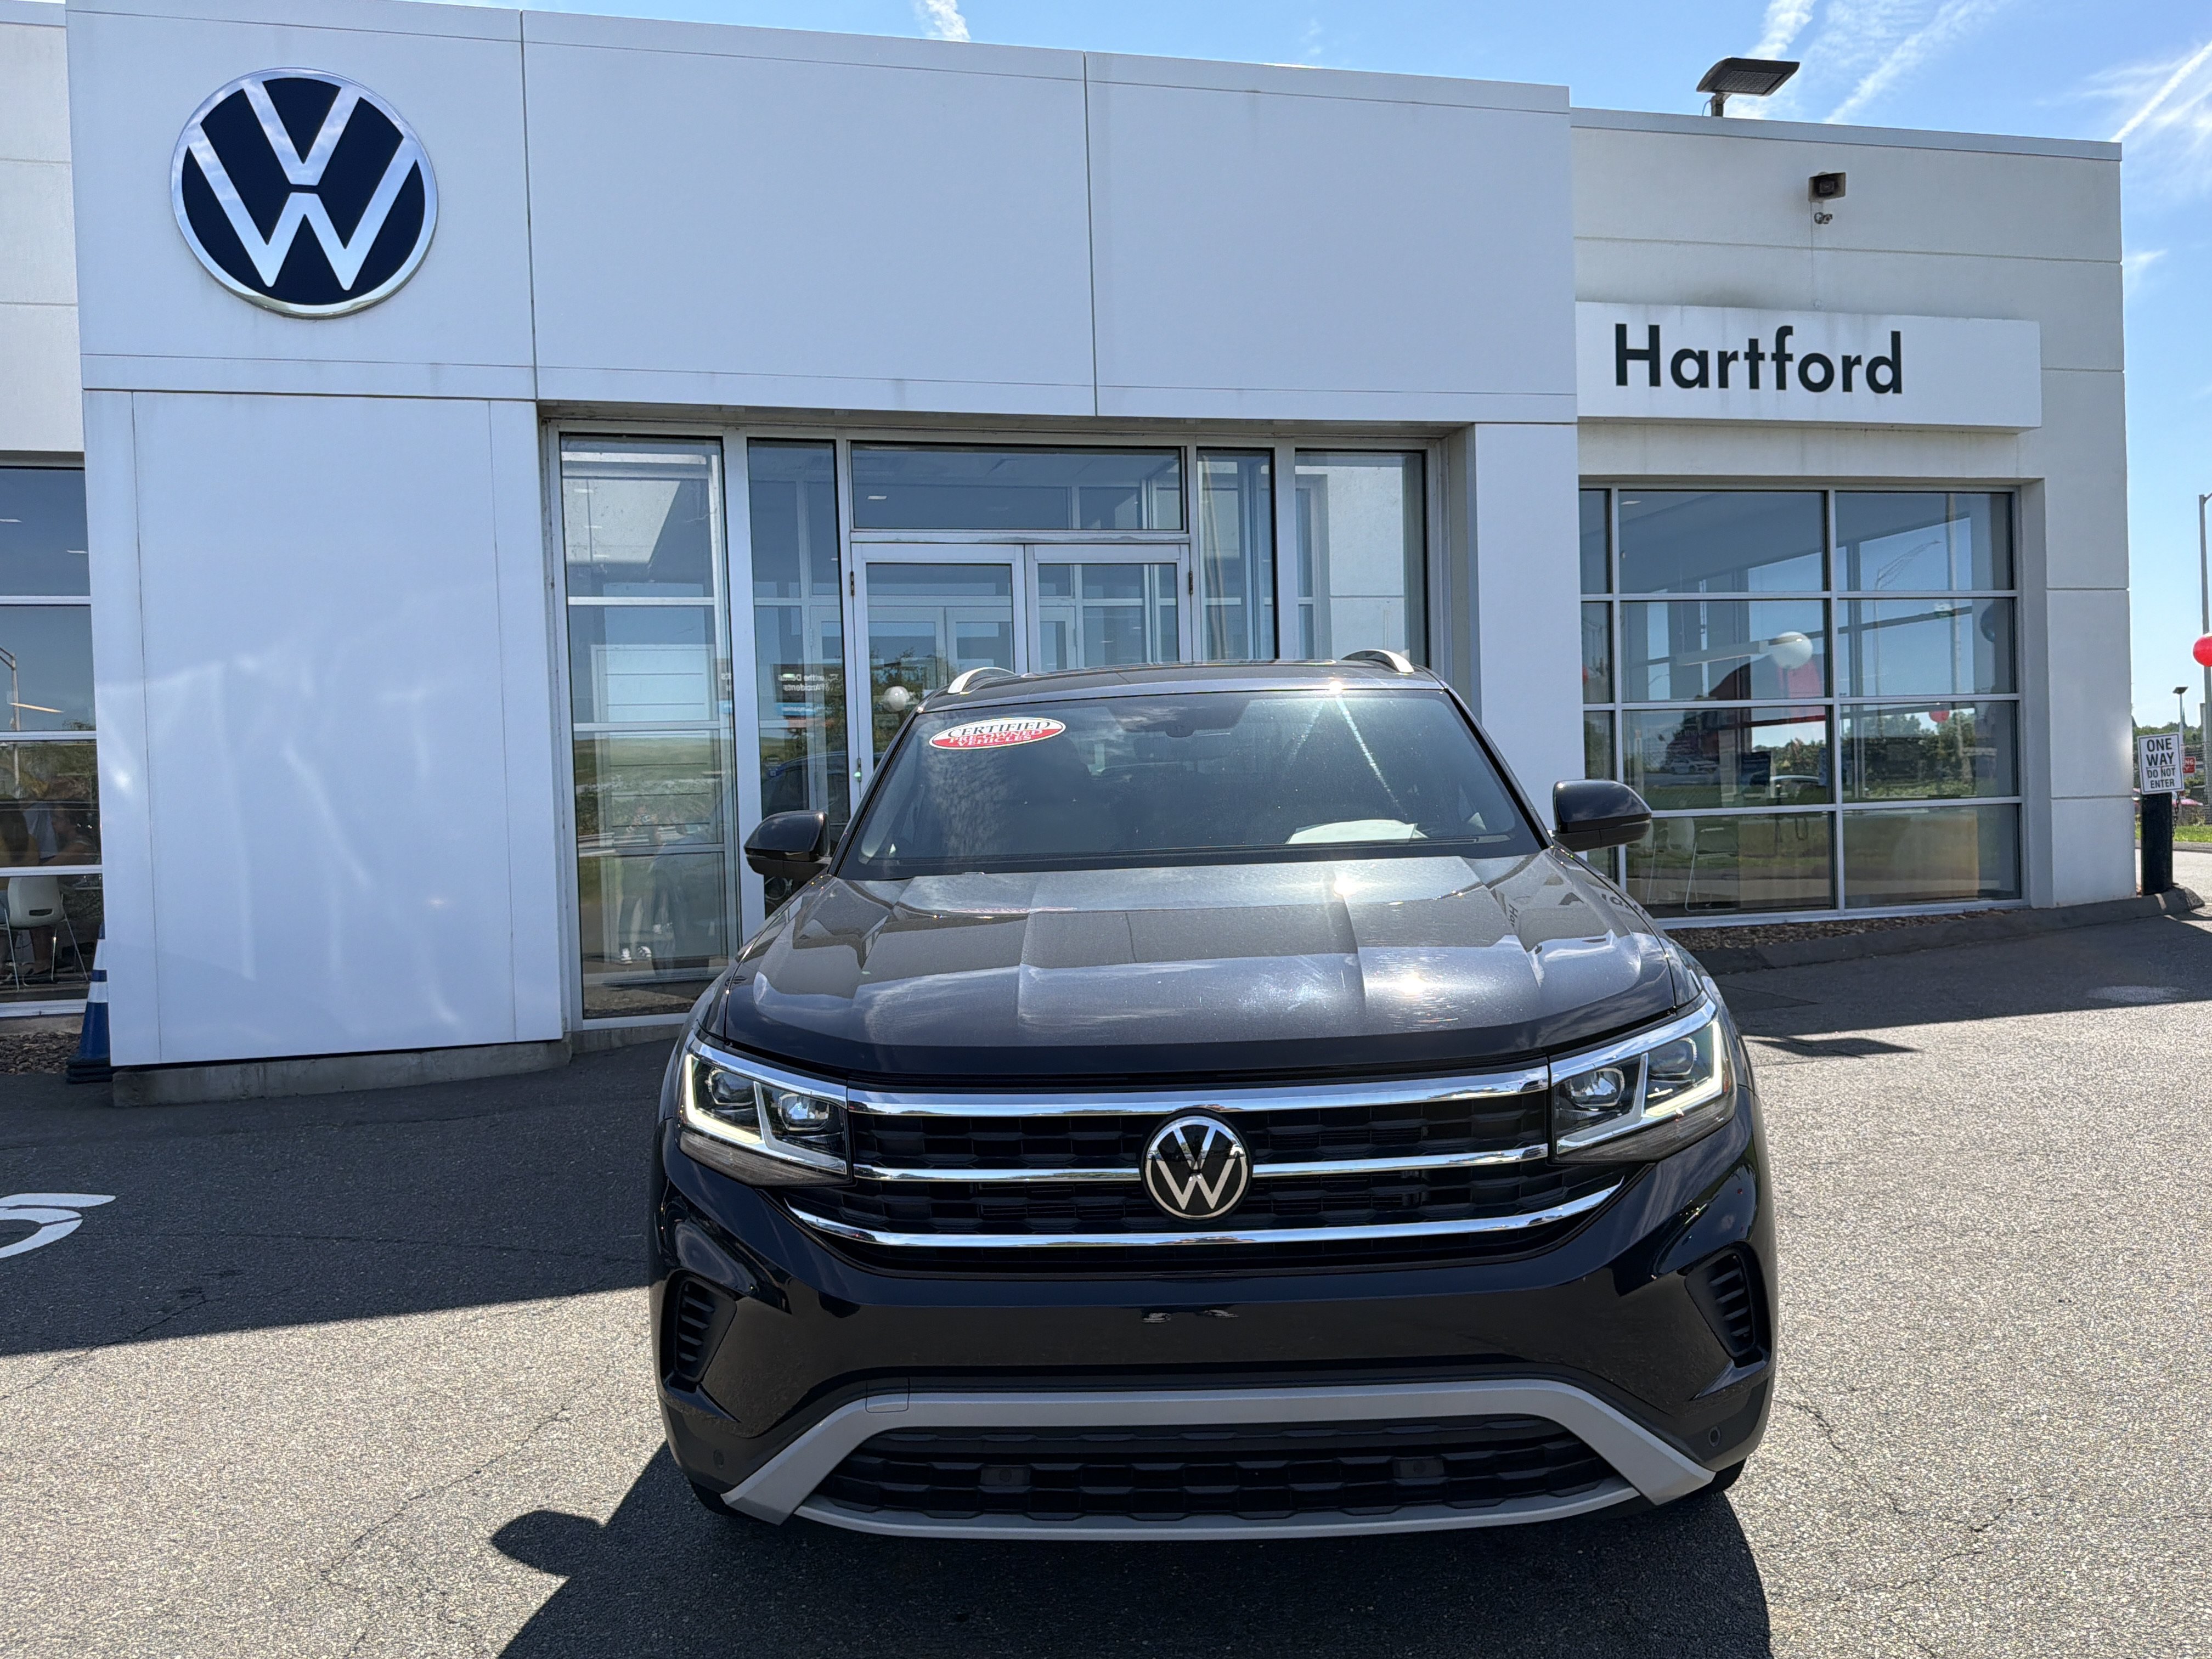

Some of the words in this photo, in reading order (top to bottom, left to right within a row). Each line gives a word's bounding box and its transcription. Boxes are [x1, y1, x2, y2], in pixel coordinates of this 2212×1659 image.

[178, 73, 428, 292] VW
[1613, 323, 1904, 395] Hartford
[947, 721, 1050, 737] CERTIFIED
[949, 730, 1043, 743] PRE-OWNED
[957, 735, 1032, 747] VEHICLES
[2147, 738, 2172, 752] ONE
[2146, 752, 2174, 766] WAY
[2147, 769, 2158, 778] DO
[2161, 768, 2176, 778] NOT
[2151, 780, 2175, 788] ENTER
[1149, 1120, 1243, 1211] VW
